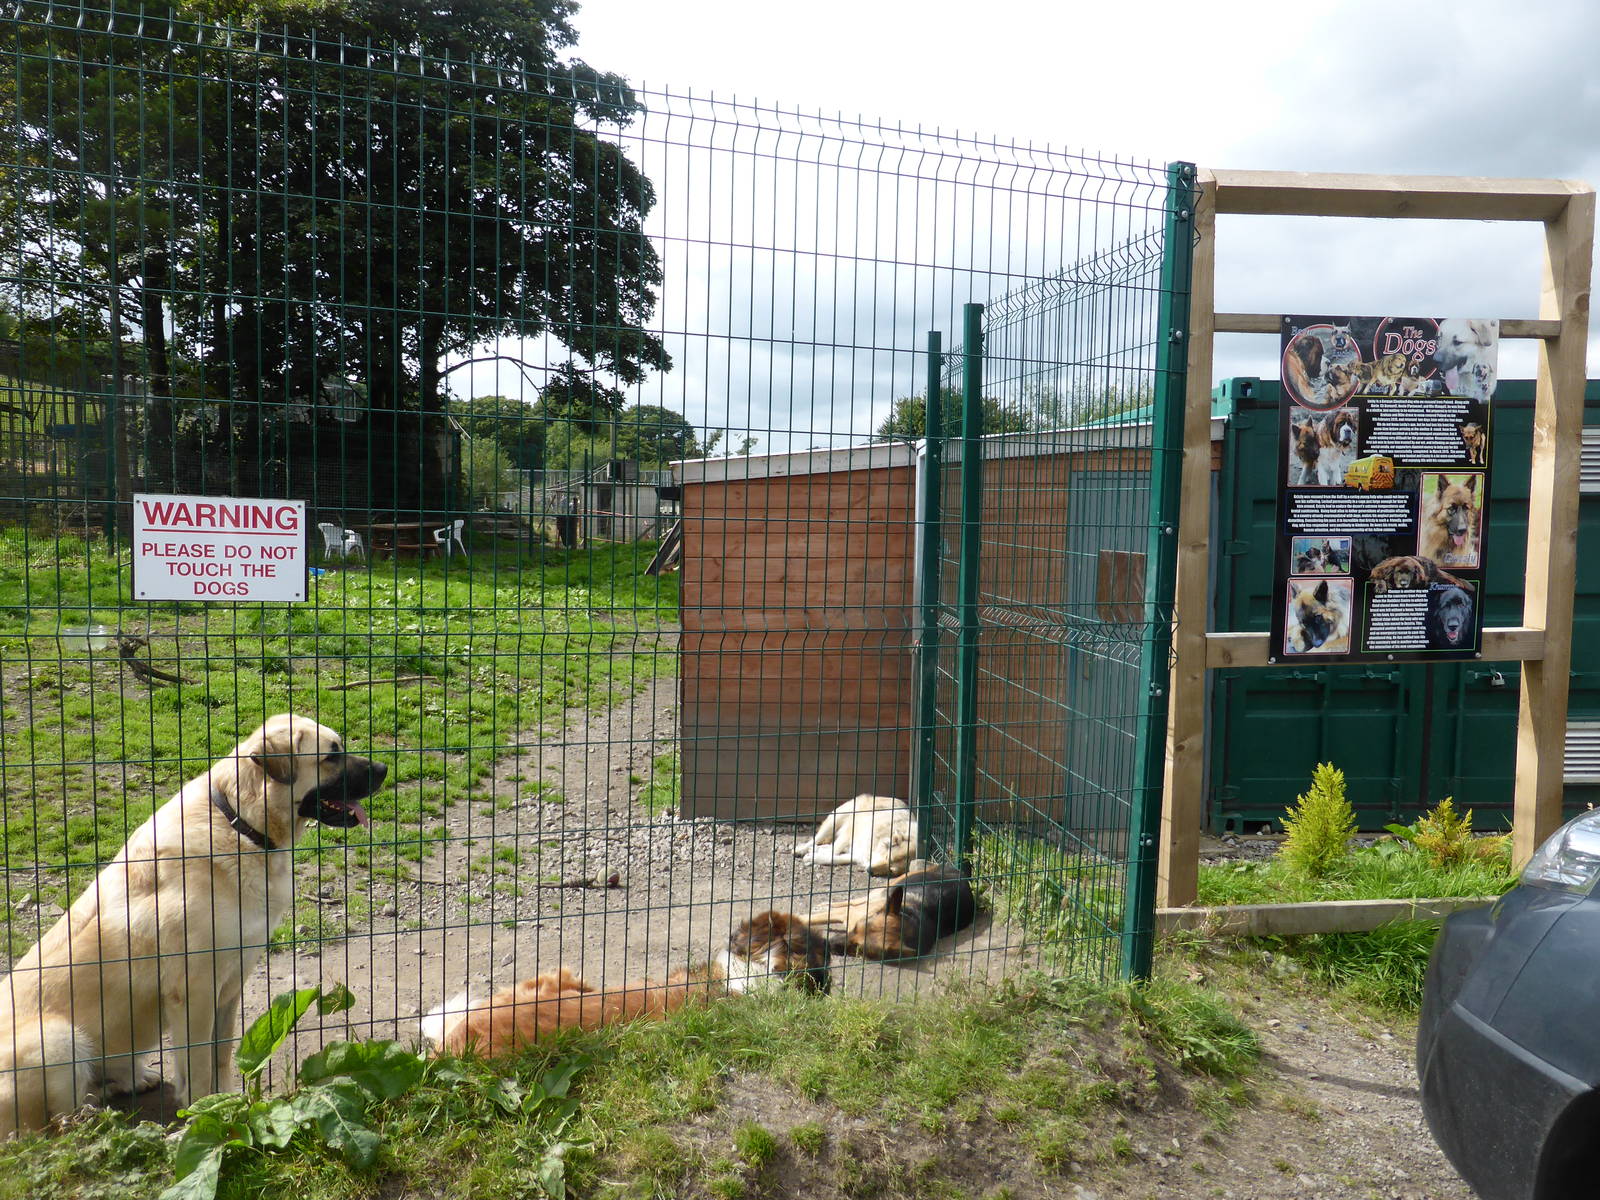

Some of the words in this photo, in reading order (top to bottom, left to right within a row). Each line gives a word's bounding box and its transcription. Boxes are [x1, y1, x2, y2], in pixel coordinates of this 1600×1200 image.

[1402, 326, 1423, 338] The
[1382, 332, 1437, 362] Dogs
[142, 501, 298, 530] WARNING
[142, 542, 216, 558] PLEASE
[224, 545, 252, 559] DO
[260, 546, 298, 560] NOT
[166, 562, 232, 577] TOUCH
[240, 563, 276, 578] THE
[194, 581, 249, 596] DOGS
